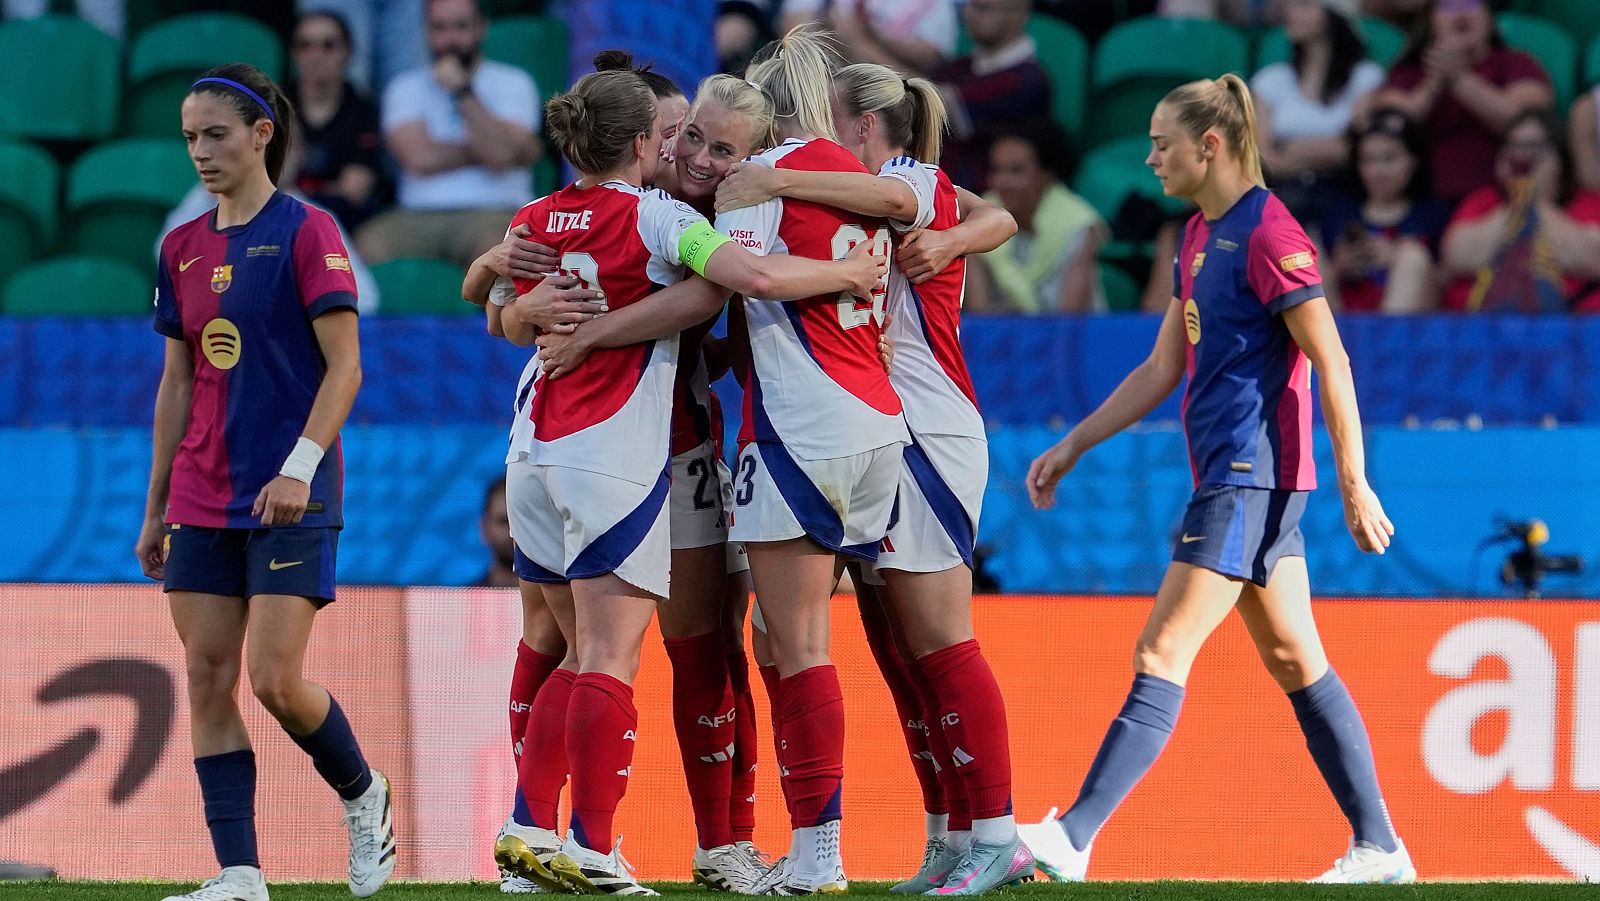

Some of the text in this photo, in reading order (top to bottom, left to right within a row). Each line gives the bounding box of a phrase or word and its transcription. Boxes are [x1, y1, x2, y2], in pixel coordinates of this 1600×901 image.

[546, 210, 593, 233] LITTLE
[729, 229, 754, 239] VISIT
[686, 240, 700, 267] SPECT
[732, 239, 762, 250] ANDA
[687, 456, 719, 510] 2
[510, 700, 532, 713] AF
[1420, 617, 1600, 795] a
[623, 729, 637, 742] A
